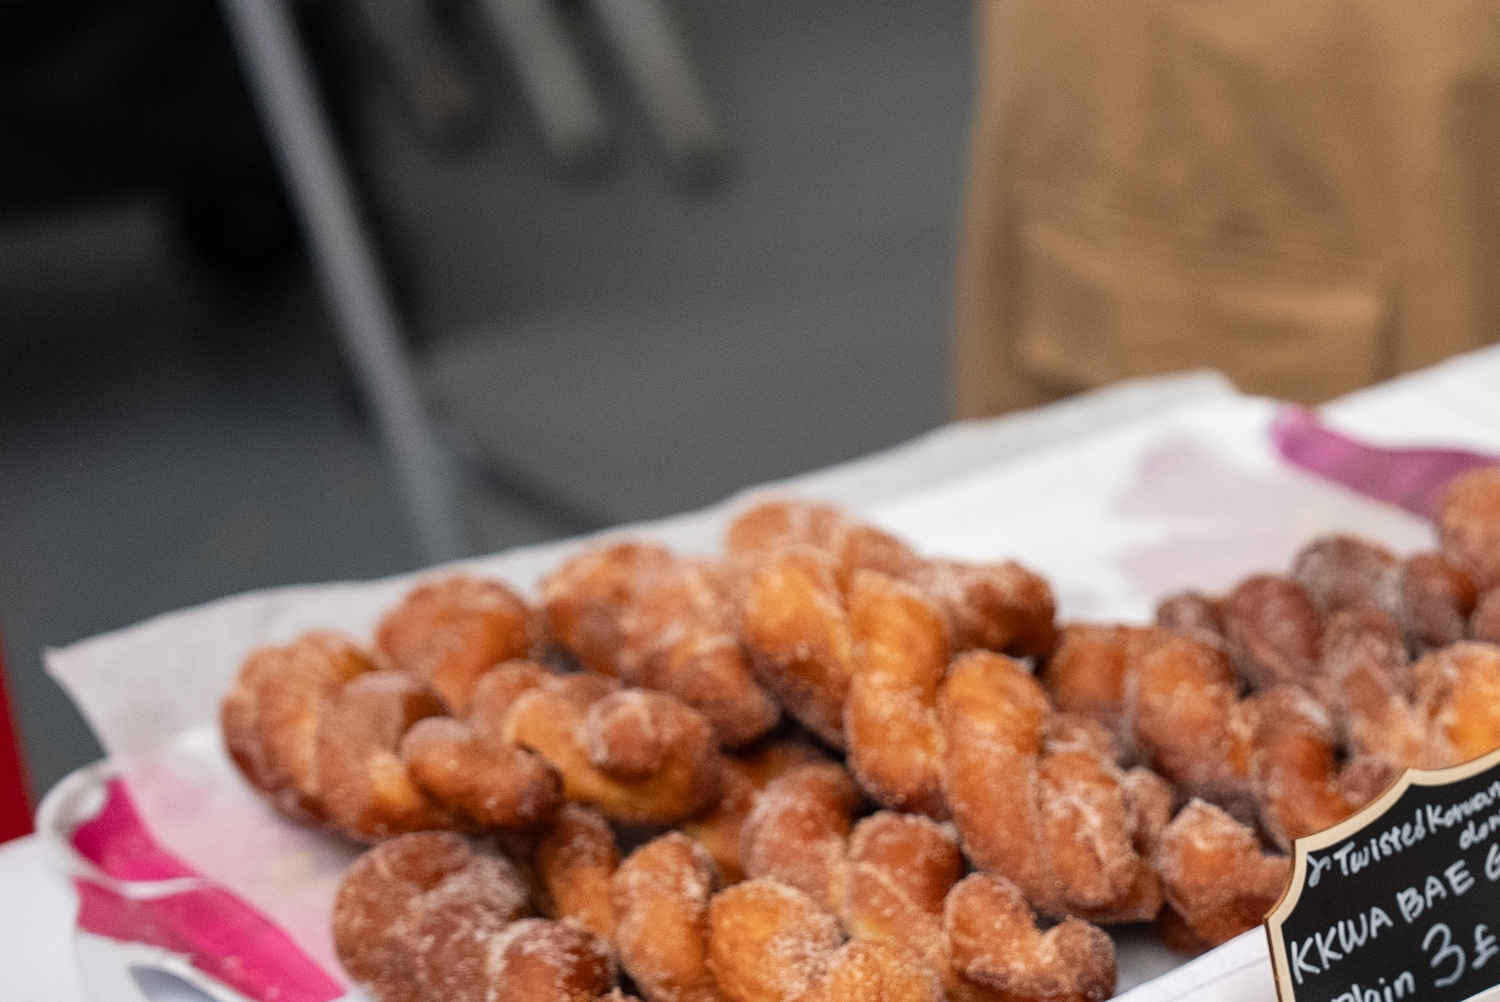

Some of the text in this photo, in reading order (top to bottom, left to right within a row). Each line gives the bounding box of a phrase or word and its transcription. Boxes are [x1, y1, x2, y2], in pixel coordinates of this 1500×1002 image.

[1333, 808, 1426, 876] Twisted
[1290, 906, 1394, 985] KKWA
[1396, 859, 1475, 924] BAE
